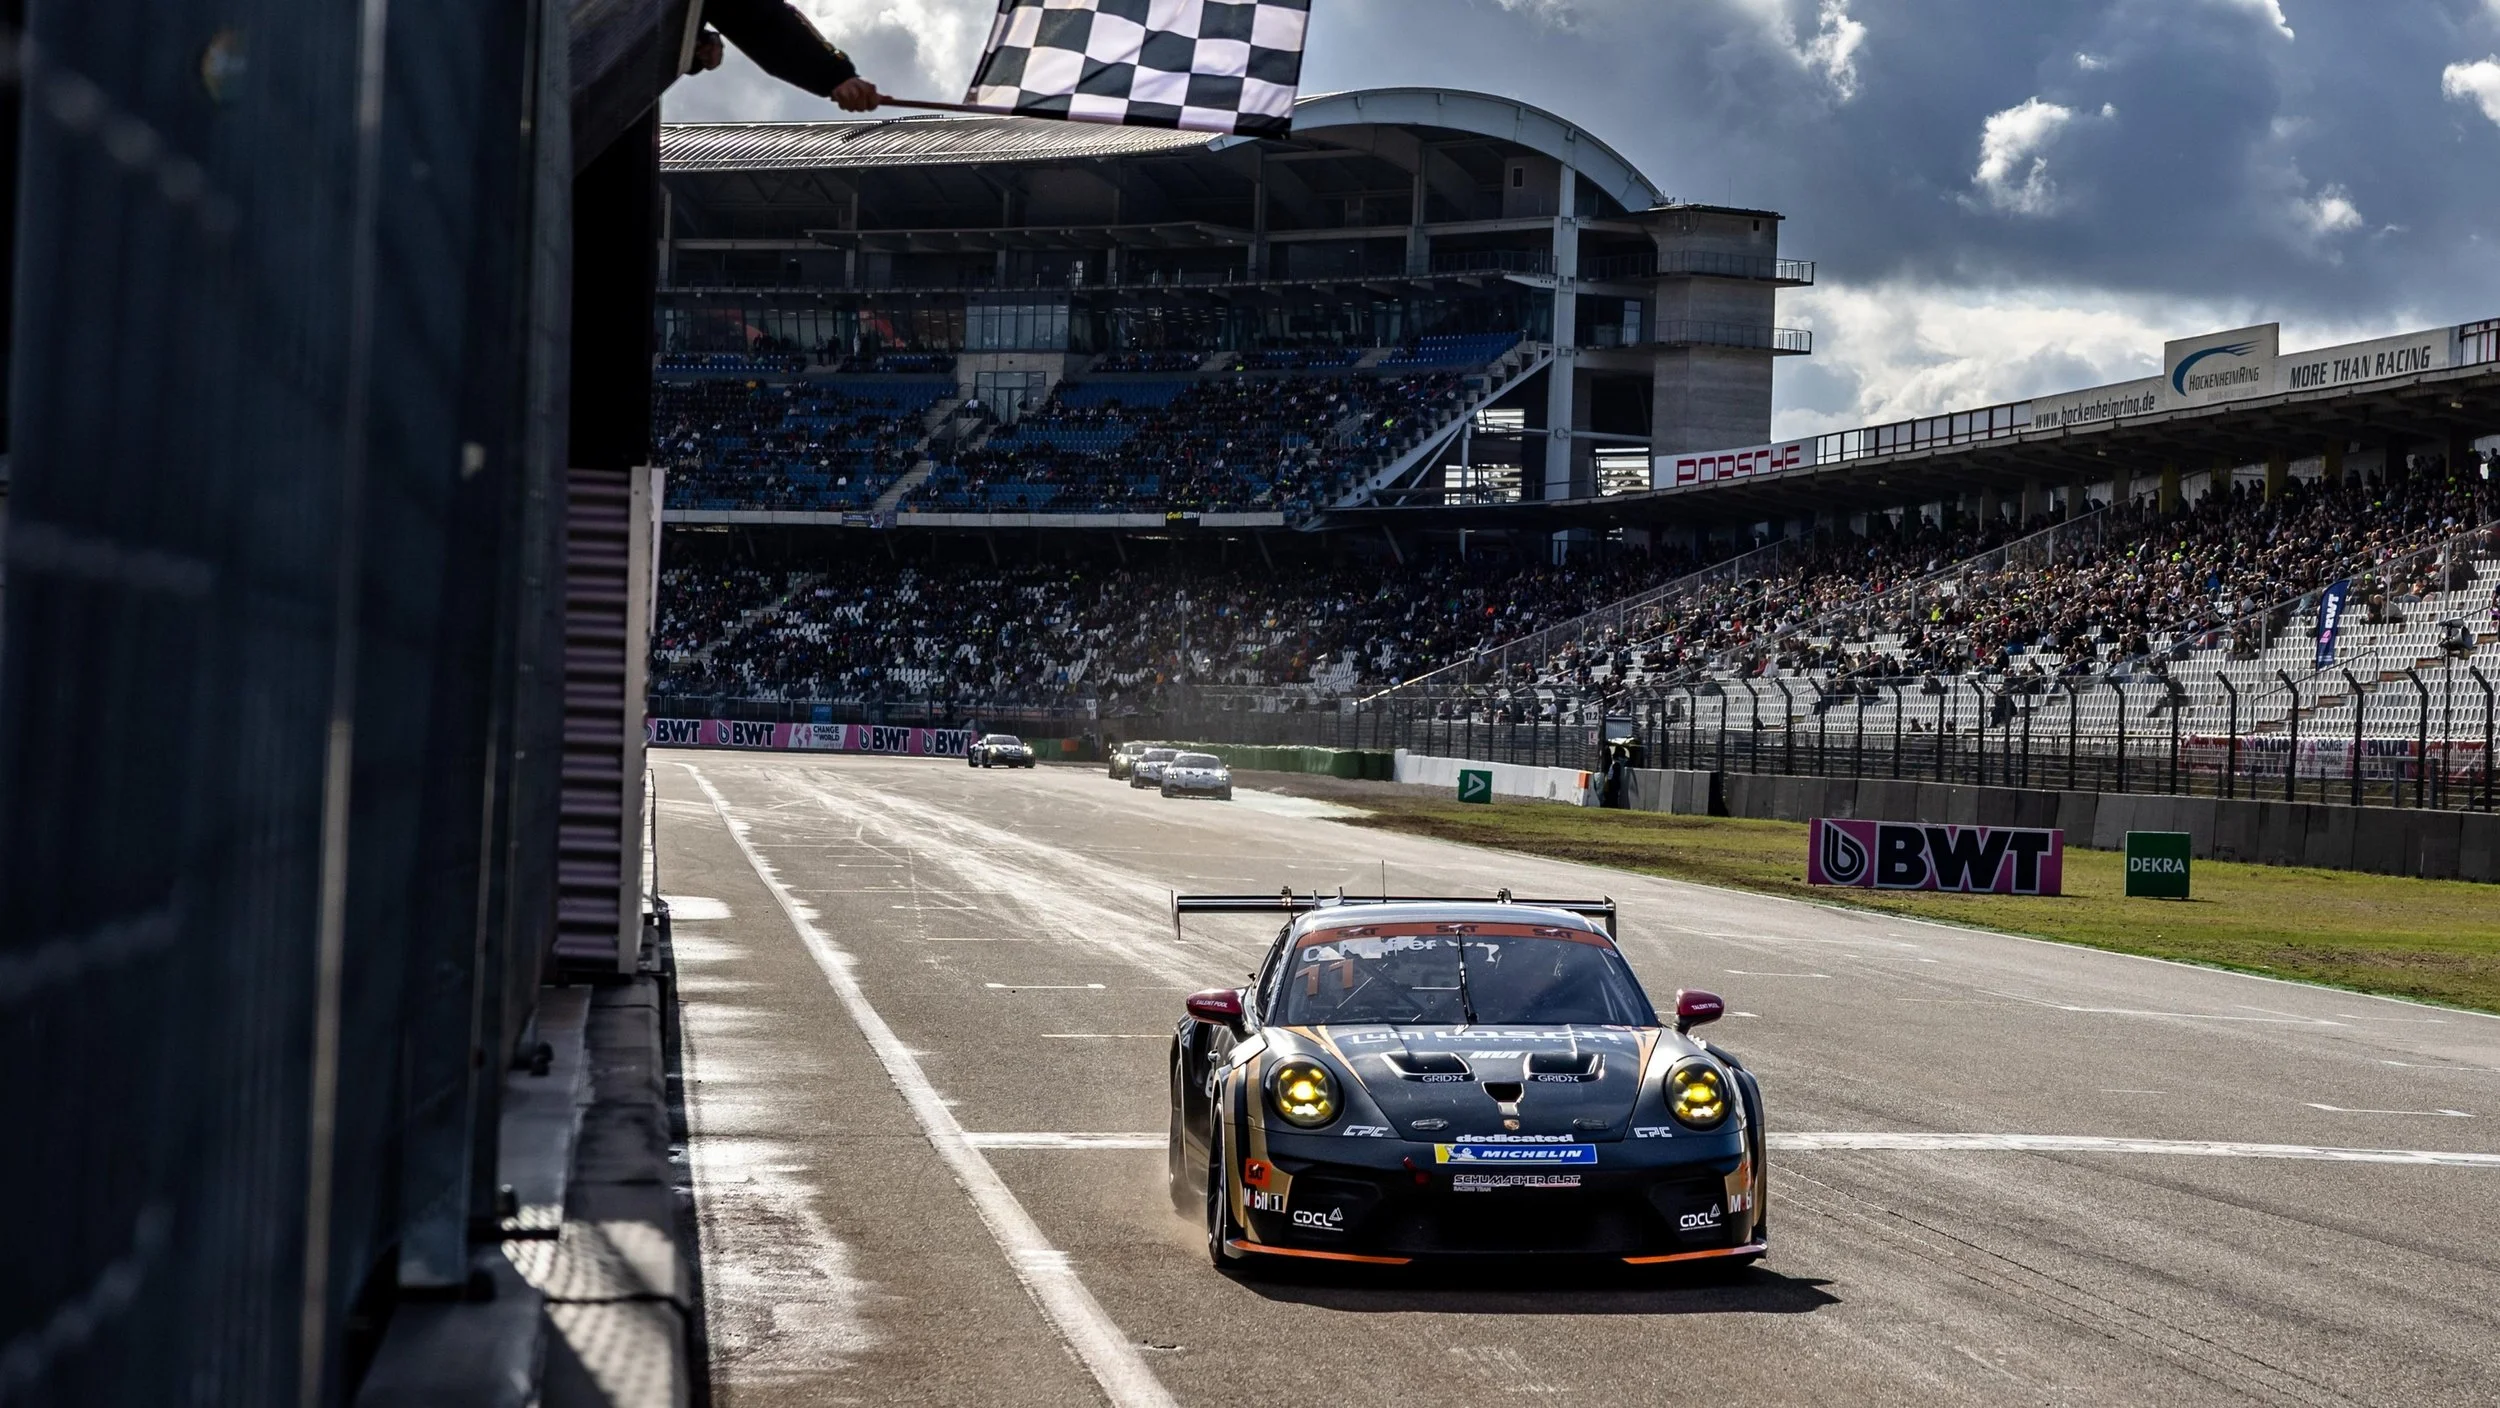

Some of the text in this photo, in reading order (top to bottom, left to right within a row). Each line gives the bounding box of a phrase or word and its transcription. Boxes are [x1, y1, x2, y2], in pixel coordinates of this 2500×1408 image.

[2290, 345, 2432, 390] MORE THAN RACING
[2035, 390, 2155, 429] www.hockenheimring.de
[1676, 445, 1800, 487] PORSCHE
[656, 718, 701, 744] BWT
[732, 720, 776, 747] BWT
[813, 725, 840, 734] CHANGE
[872, 726, 910, 752] BWT
[933, 729, 973, 755] BWT
[1874, 821, 2054, 894] BWT
[2130, 857, 2186, 874] DEKRA
[1456, 1133, 1574, 1143] dedicated
[1482, 1149, 1583, 1158] MICHELIN
[1453, 1174, 1581, 1186] SCHUMACHER CLRT
[1293, 1210, 1333, 1227] CDCL
[1680, 1212, 1714, 1228] CDCL
